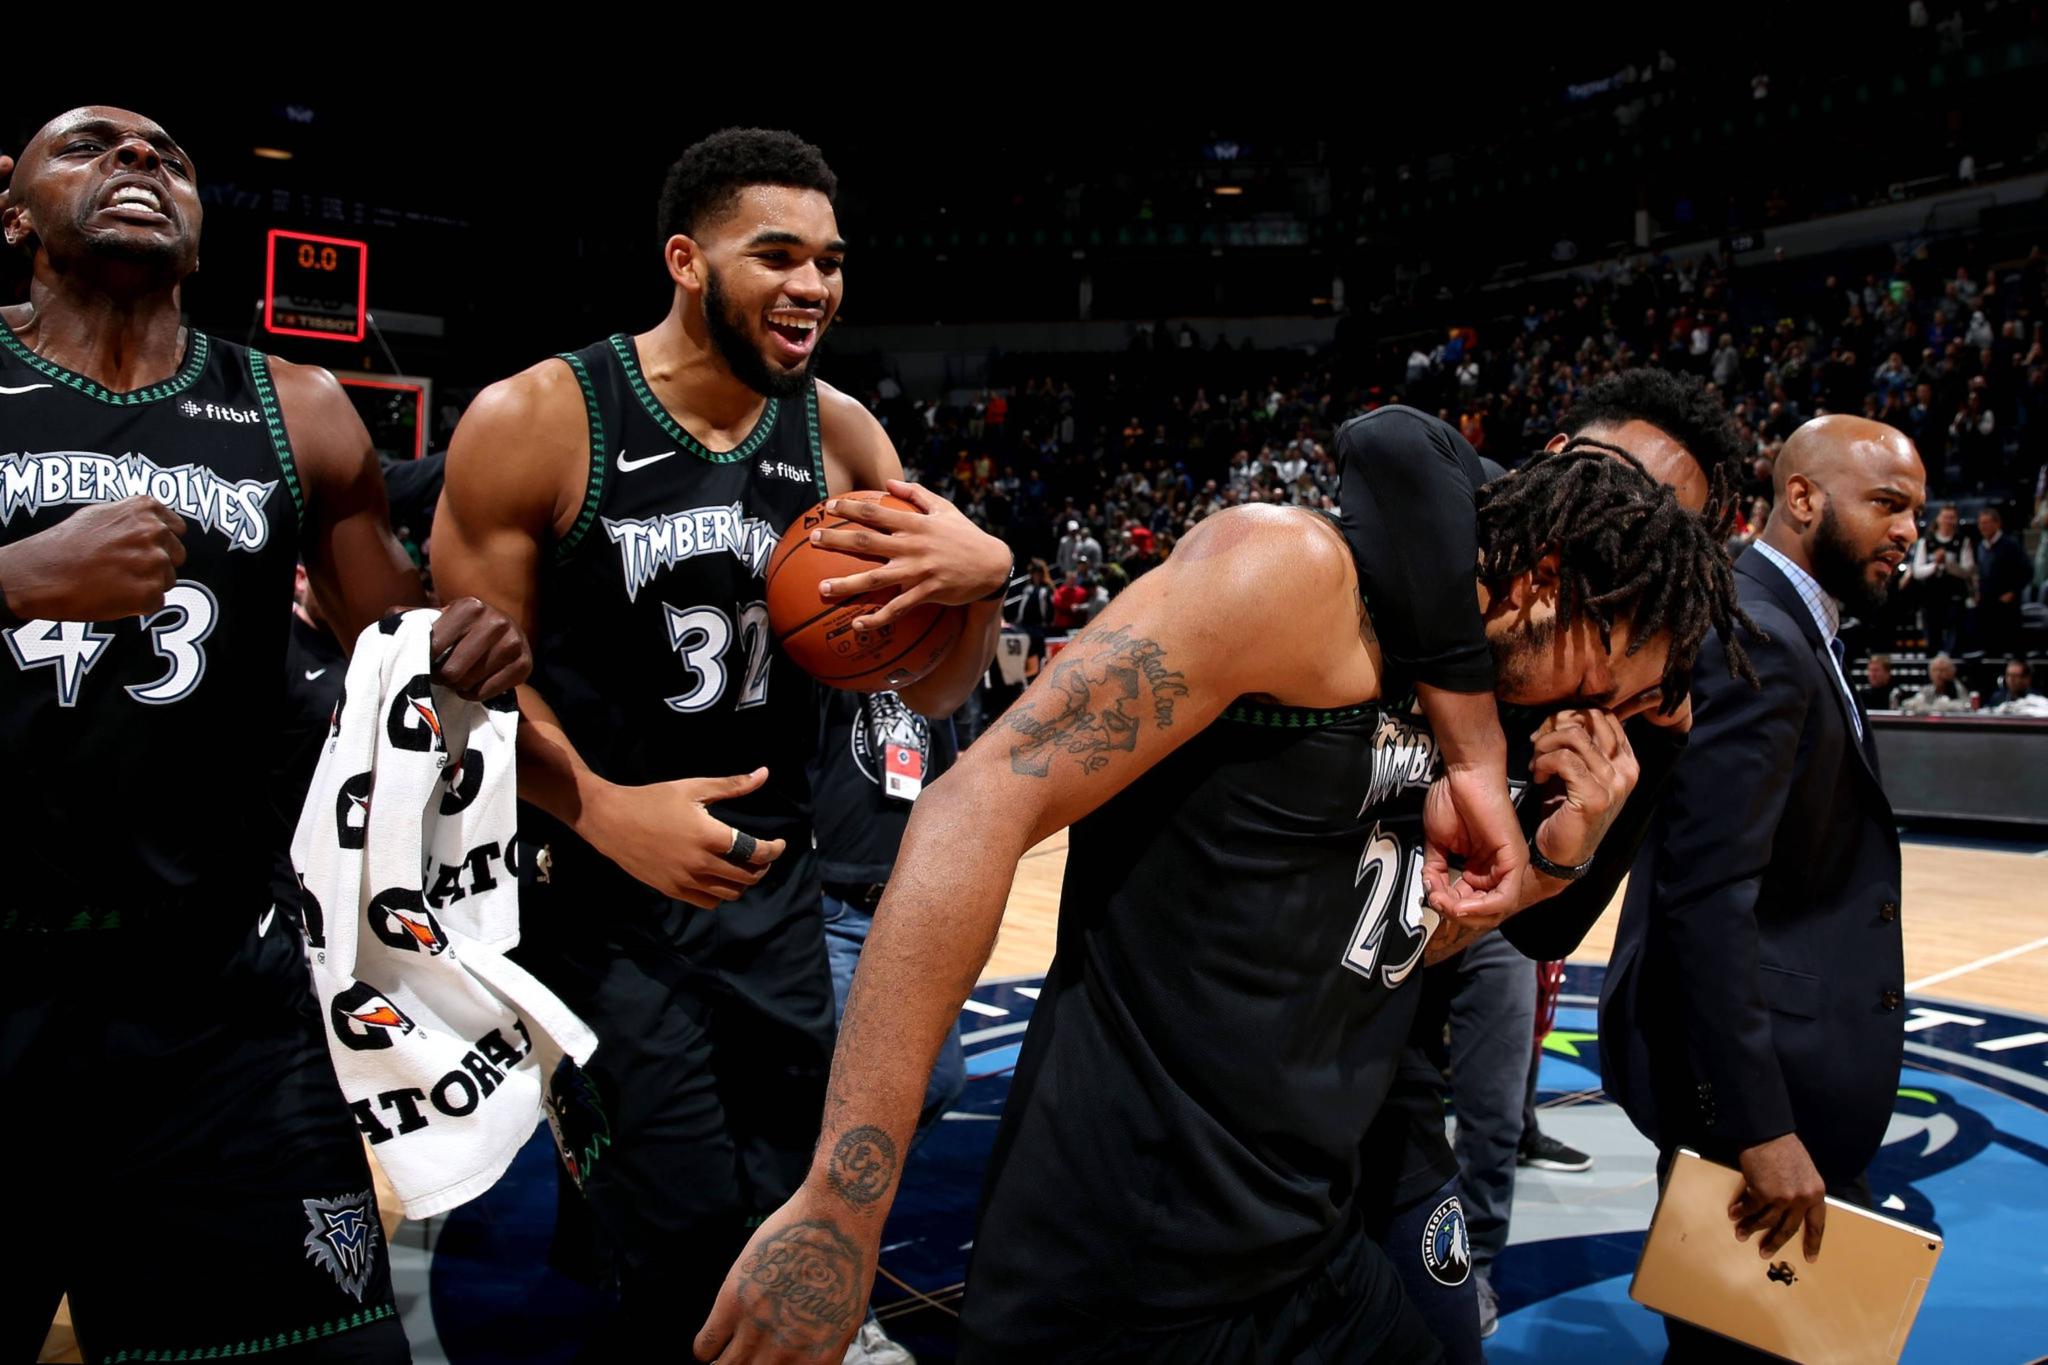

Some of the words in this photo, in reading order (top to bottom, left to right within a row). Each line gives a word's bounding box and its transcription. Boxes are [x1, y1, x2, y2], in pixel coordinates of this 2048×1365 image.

[298, 243, 338, 271] 0.0
[206, 404, 260, 424] fitbit
[0, 451, 279, 552] MBERWOLVES
[777, 462, 812, 483] fitbit
[2, 579, 219, 707] 43
[661, 599, 773, 713] 32
[1341, 819, 1441, 990] 25
